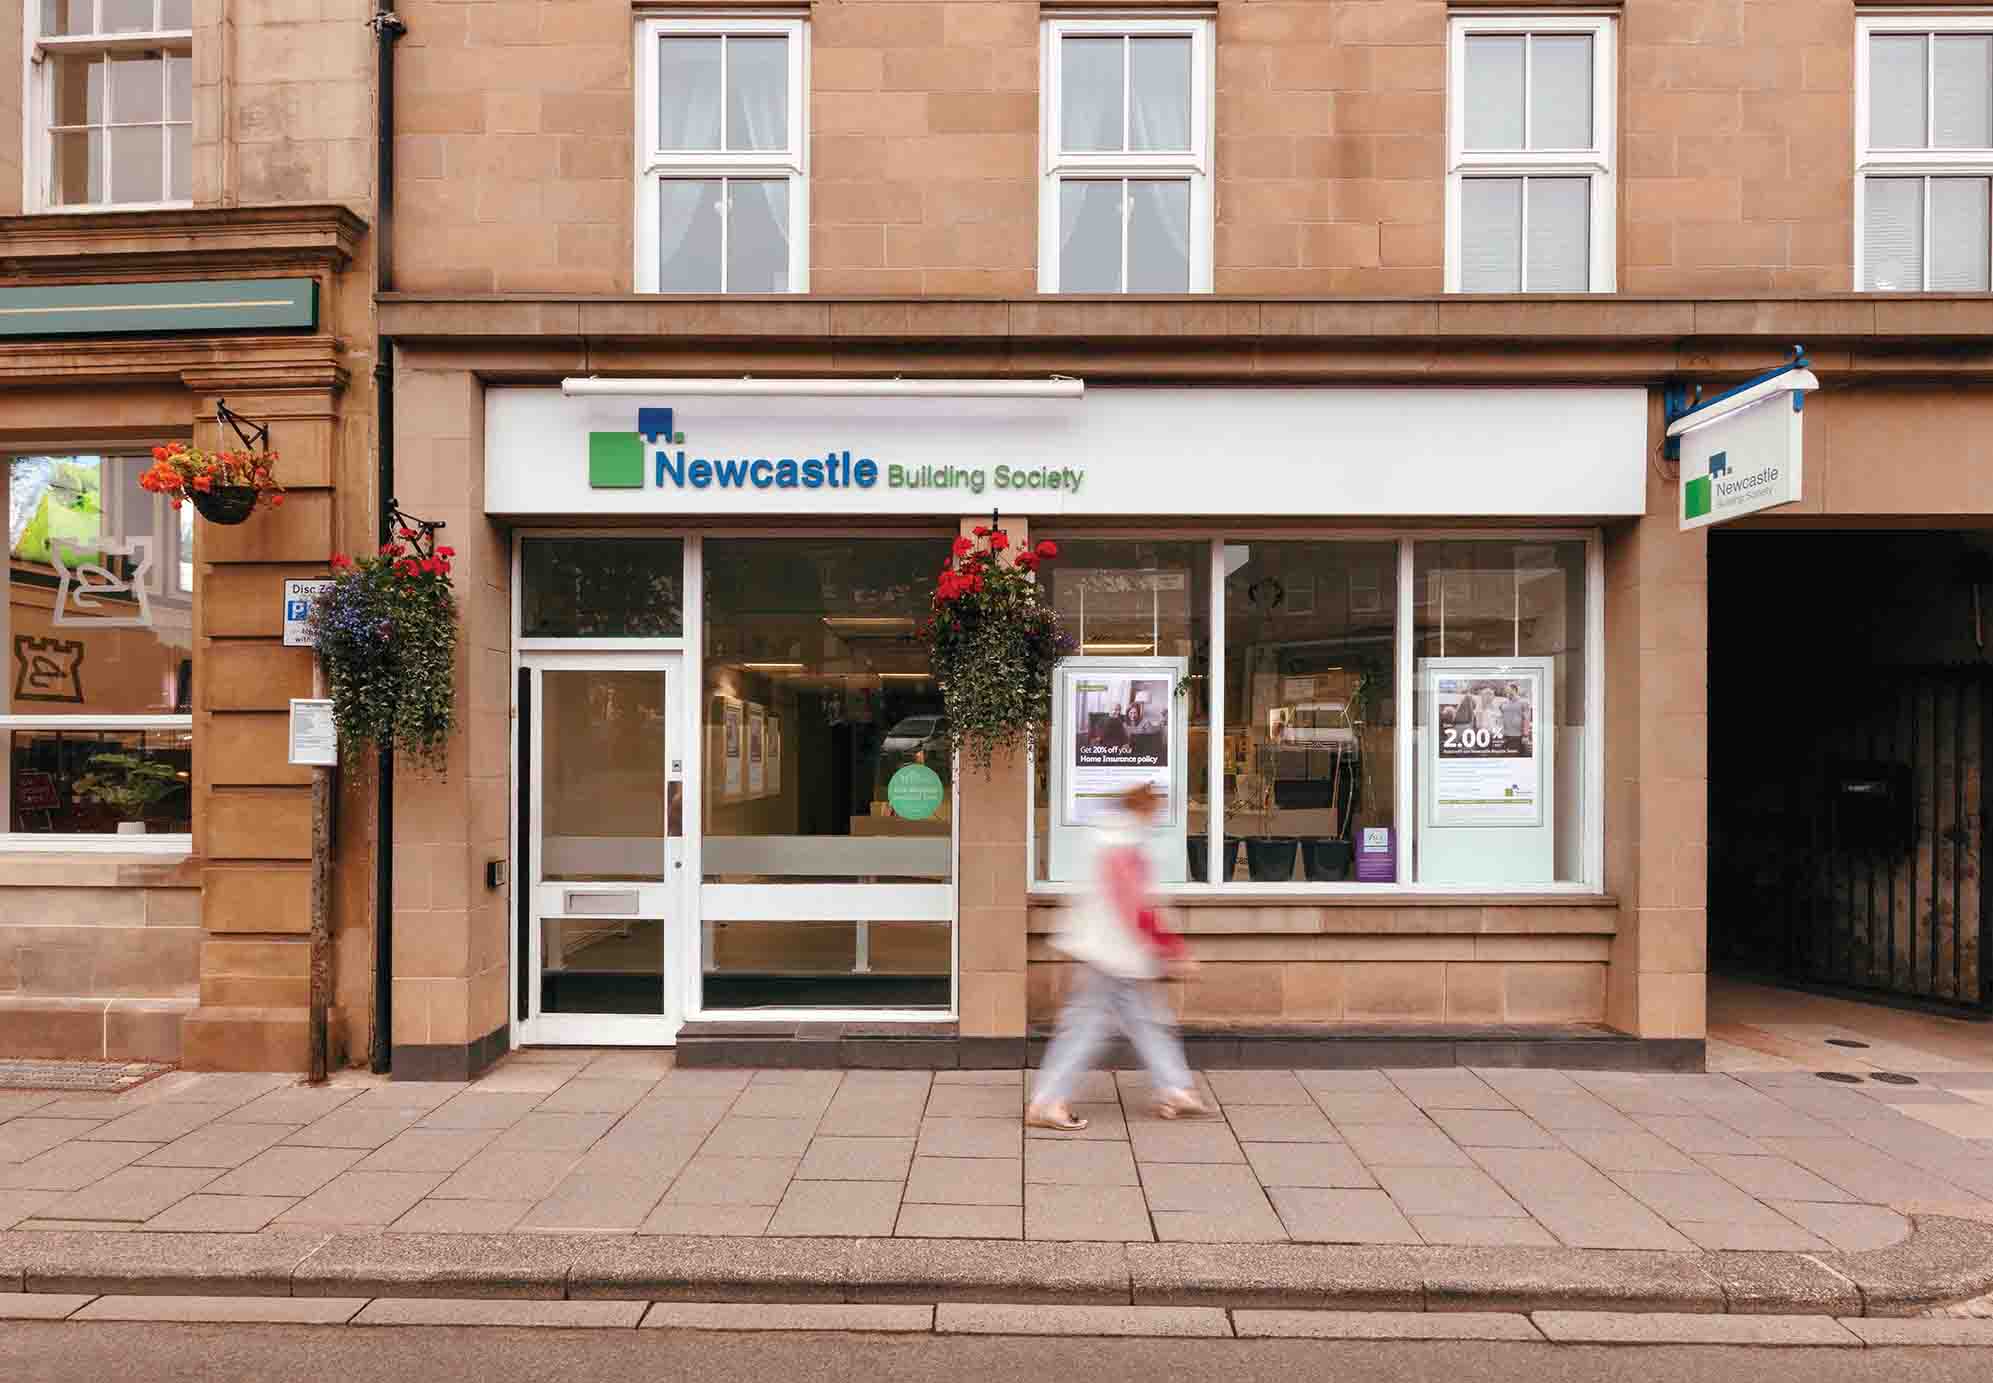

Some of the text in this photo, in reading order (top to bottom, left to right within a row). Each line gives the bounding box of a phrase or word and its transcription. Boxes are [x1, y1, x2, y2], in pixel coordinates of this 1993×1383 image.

[655, 451, 1084, 493] Newcastle Building Society
[1717, 467, 1778, 497] Newcastle
[293, 584, 316, 594] Disc
[1080, 746, 1132, 756] Get 20% off your
[1080, 755, 1158, 764] Home Insurance policy
